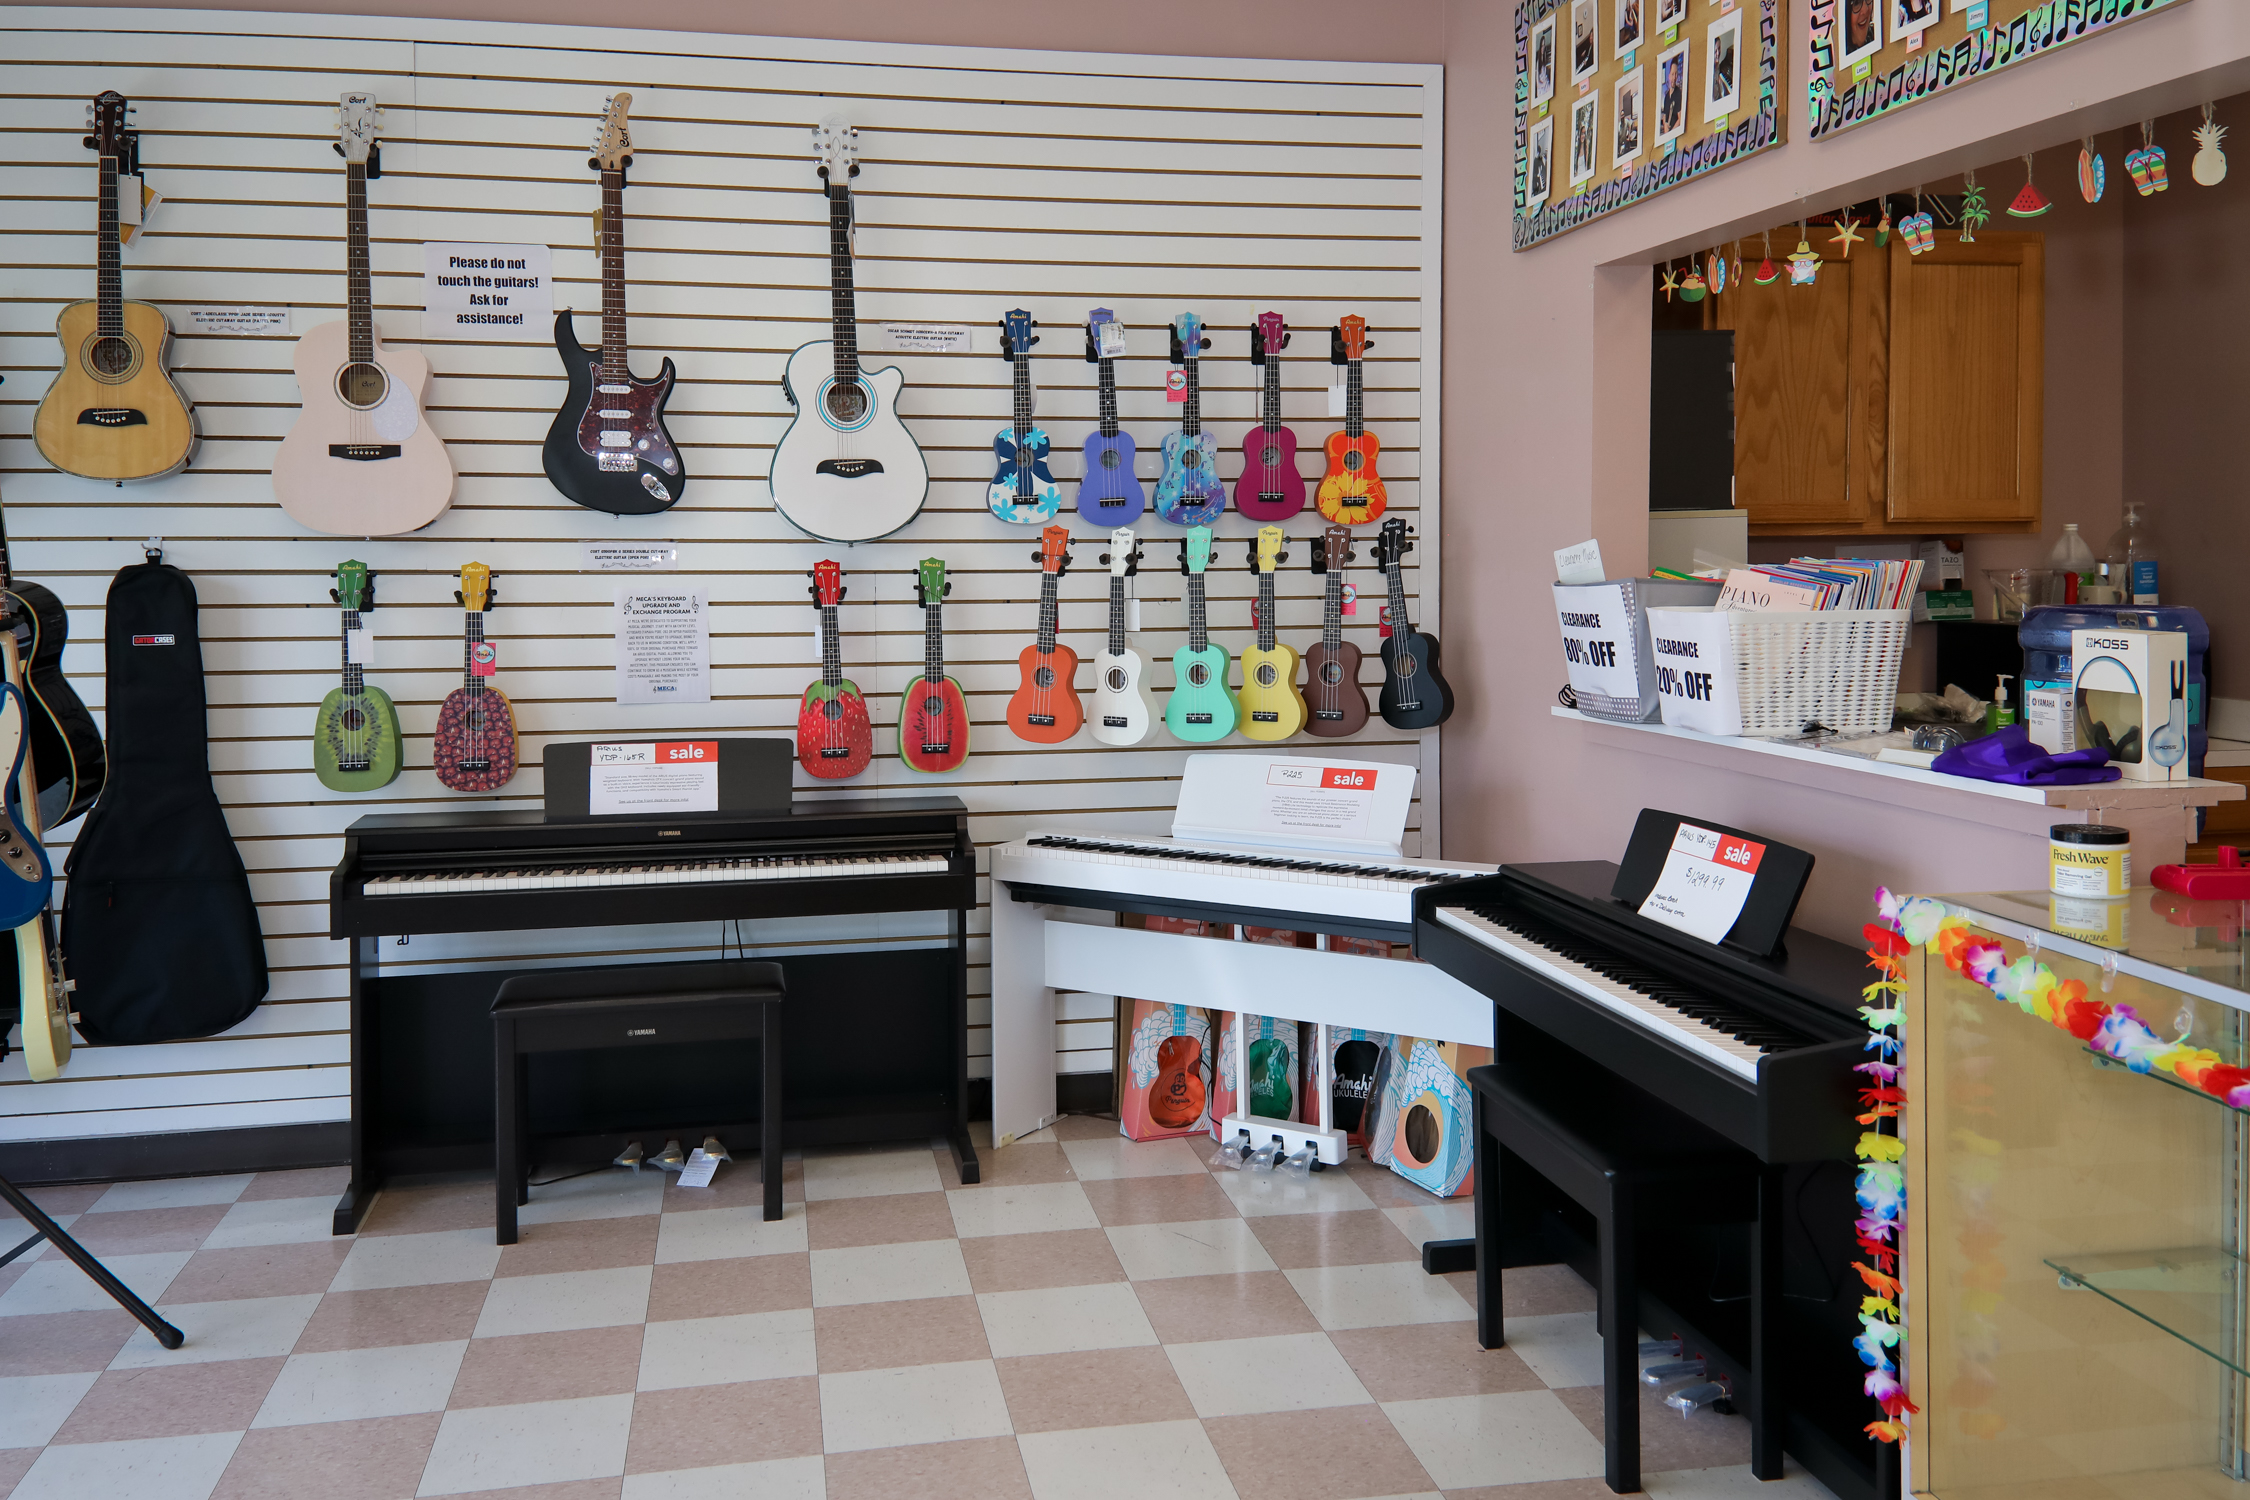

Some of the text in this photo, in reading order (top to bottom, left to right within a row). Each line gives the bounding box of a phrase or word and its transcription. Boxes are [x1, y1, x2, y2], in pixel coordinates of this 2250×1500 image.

[1970, 11, 1984, 21] Jimmy
[348, 96, 367, 104] Cort
[618, 124, 630, 148] Cort
[1807, 214, 1871, 225] uitar Sand
[449, 256, 526, 270] Please do not
[438, 275, 539, 288] touch the guitars!
[469, 294, 509, 306] Ask for
[456, 312, 523, 324] assistance!
[1940, 556, 1959, 564] TAZO
[1720, 585, 1771, 608] PIANO
[1561, 612, 1602, 629] CLEARANCE
[1656, 637, 1699, 659] CLEARANCE
[2093, 638, 2129, 650] KOSS
[1563, 636, 1616, 668] 80% OFF
[1656, 665, 1713, 702] 20% OFF
[2037, 698, 2056, 708] YAMAHA
[669, 744, 704, 760] sale
[1333, 771, 1365, 786] sale
[1723, 843, 1751, 866] sale
[2053, 848, 2109, 865] Fresh Wave
[634, 1028, 656, 1036] YAMAHA
[1333, 1073, 1372, 1091] Amahi
[1333, 1089, 1368, 1099] UKULELE
